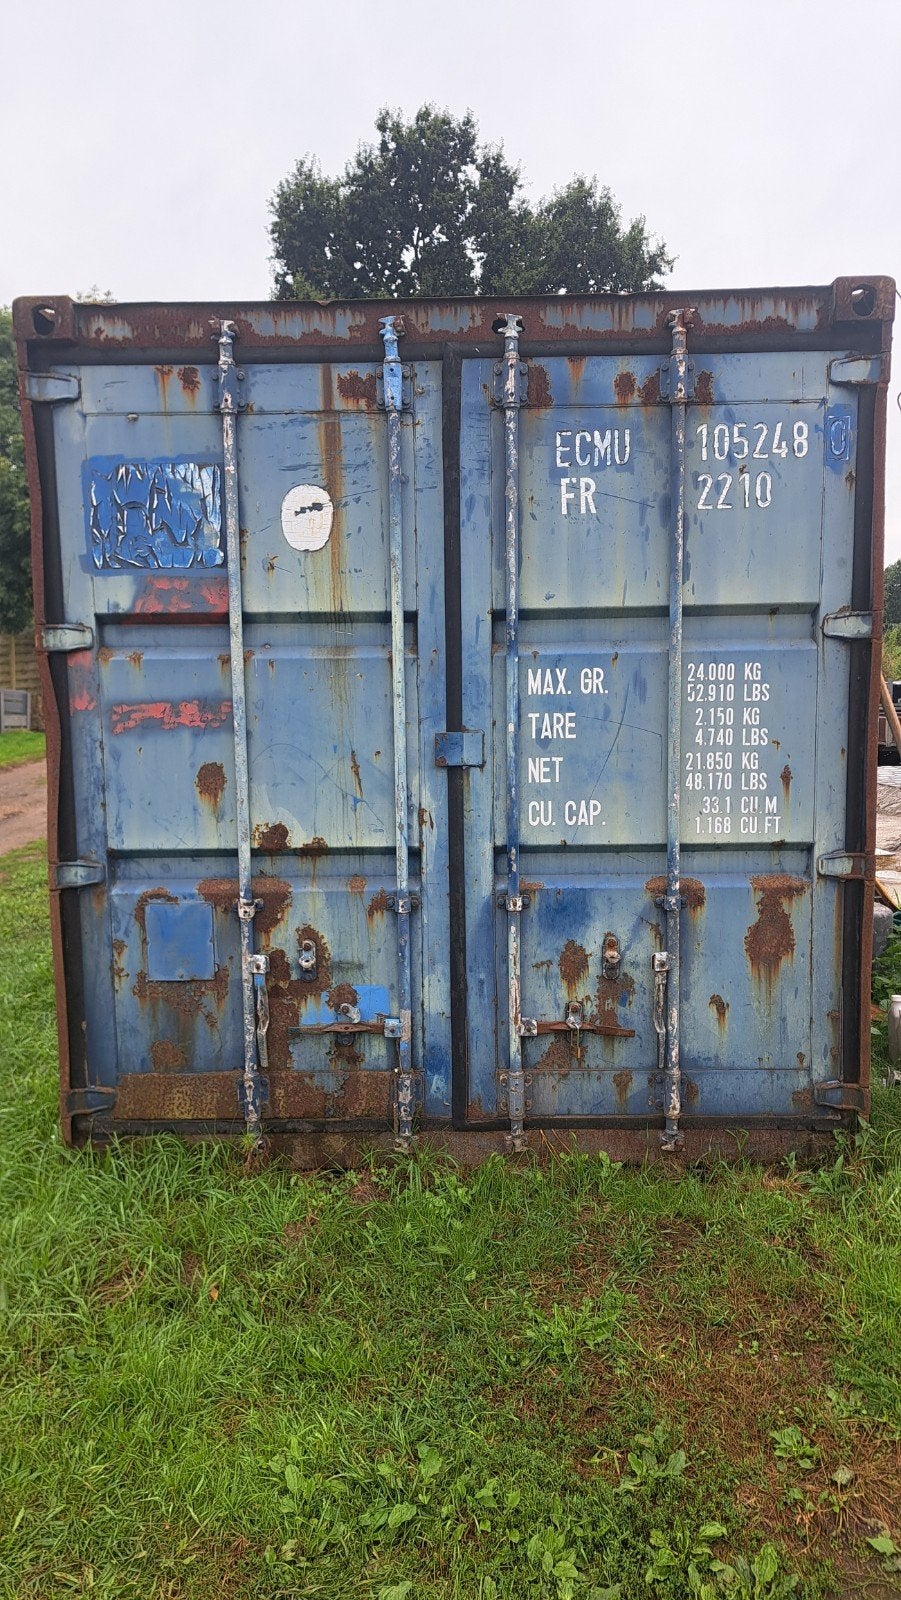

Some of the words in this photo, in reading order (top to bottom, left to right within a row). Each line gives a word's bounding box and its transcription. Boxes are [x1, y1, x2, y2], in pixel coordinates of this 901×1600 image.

[555, 428, 631, 468] ECMU
[696, 420, 809, 462] 105248
[560, 477, 597, 515] FR
[697, 471, 773, 510] 2210
[744, 662, 762, 681] KG
[527, 668, 571, 696] MAX.
[580, 667, 608, 695] GR.
[743, 683, 770, 702] LBS
[528, 712, 577, 739] TARE
[742, 707, 760, 726] KG
[742, 728, 769, 746] LBS
[527, 757, 564, 784] NET
[741, 752, 759, 770] KG
[741, 772, 768, 791] LBS
[528, 801, 556, 826] CU.
[564, 800, 607, 826] CAP.
[702, 796, 731, 814] 33.1
[695, 816, 731, 834] 1.168
